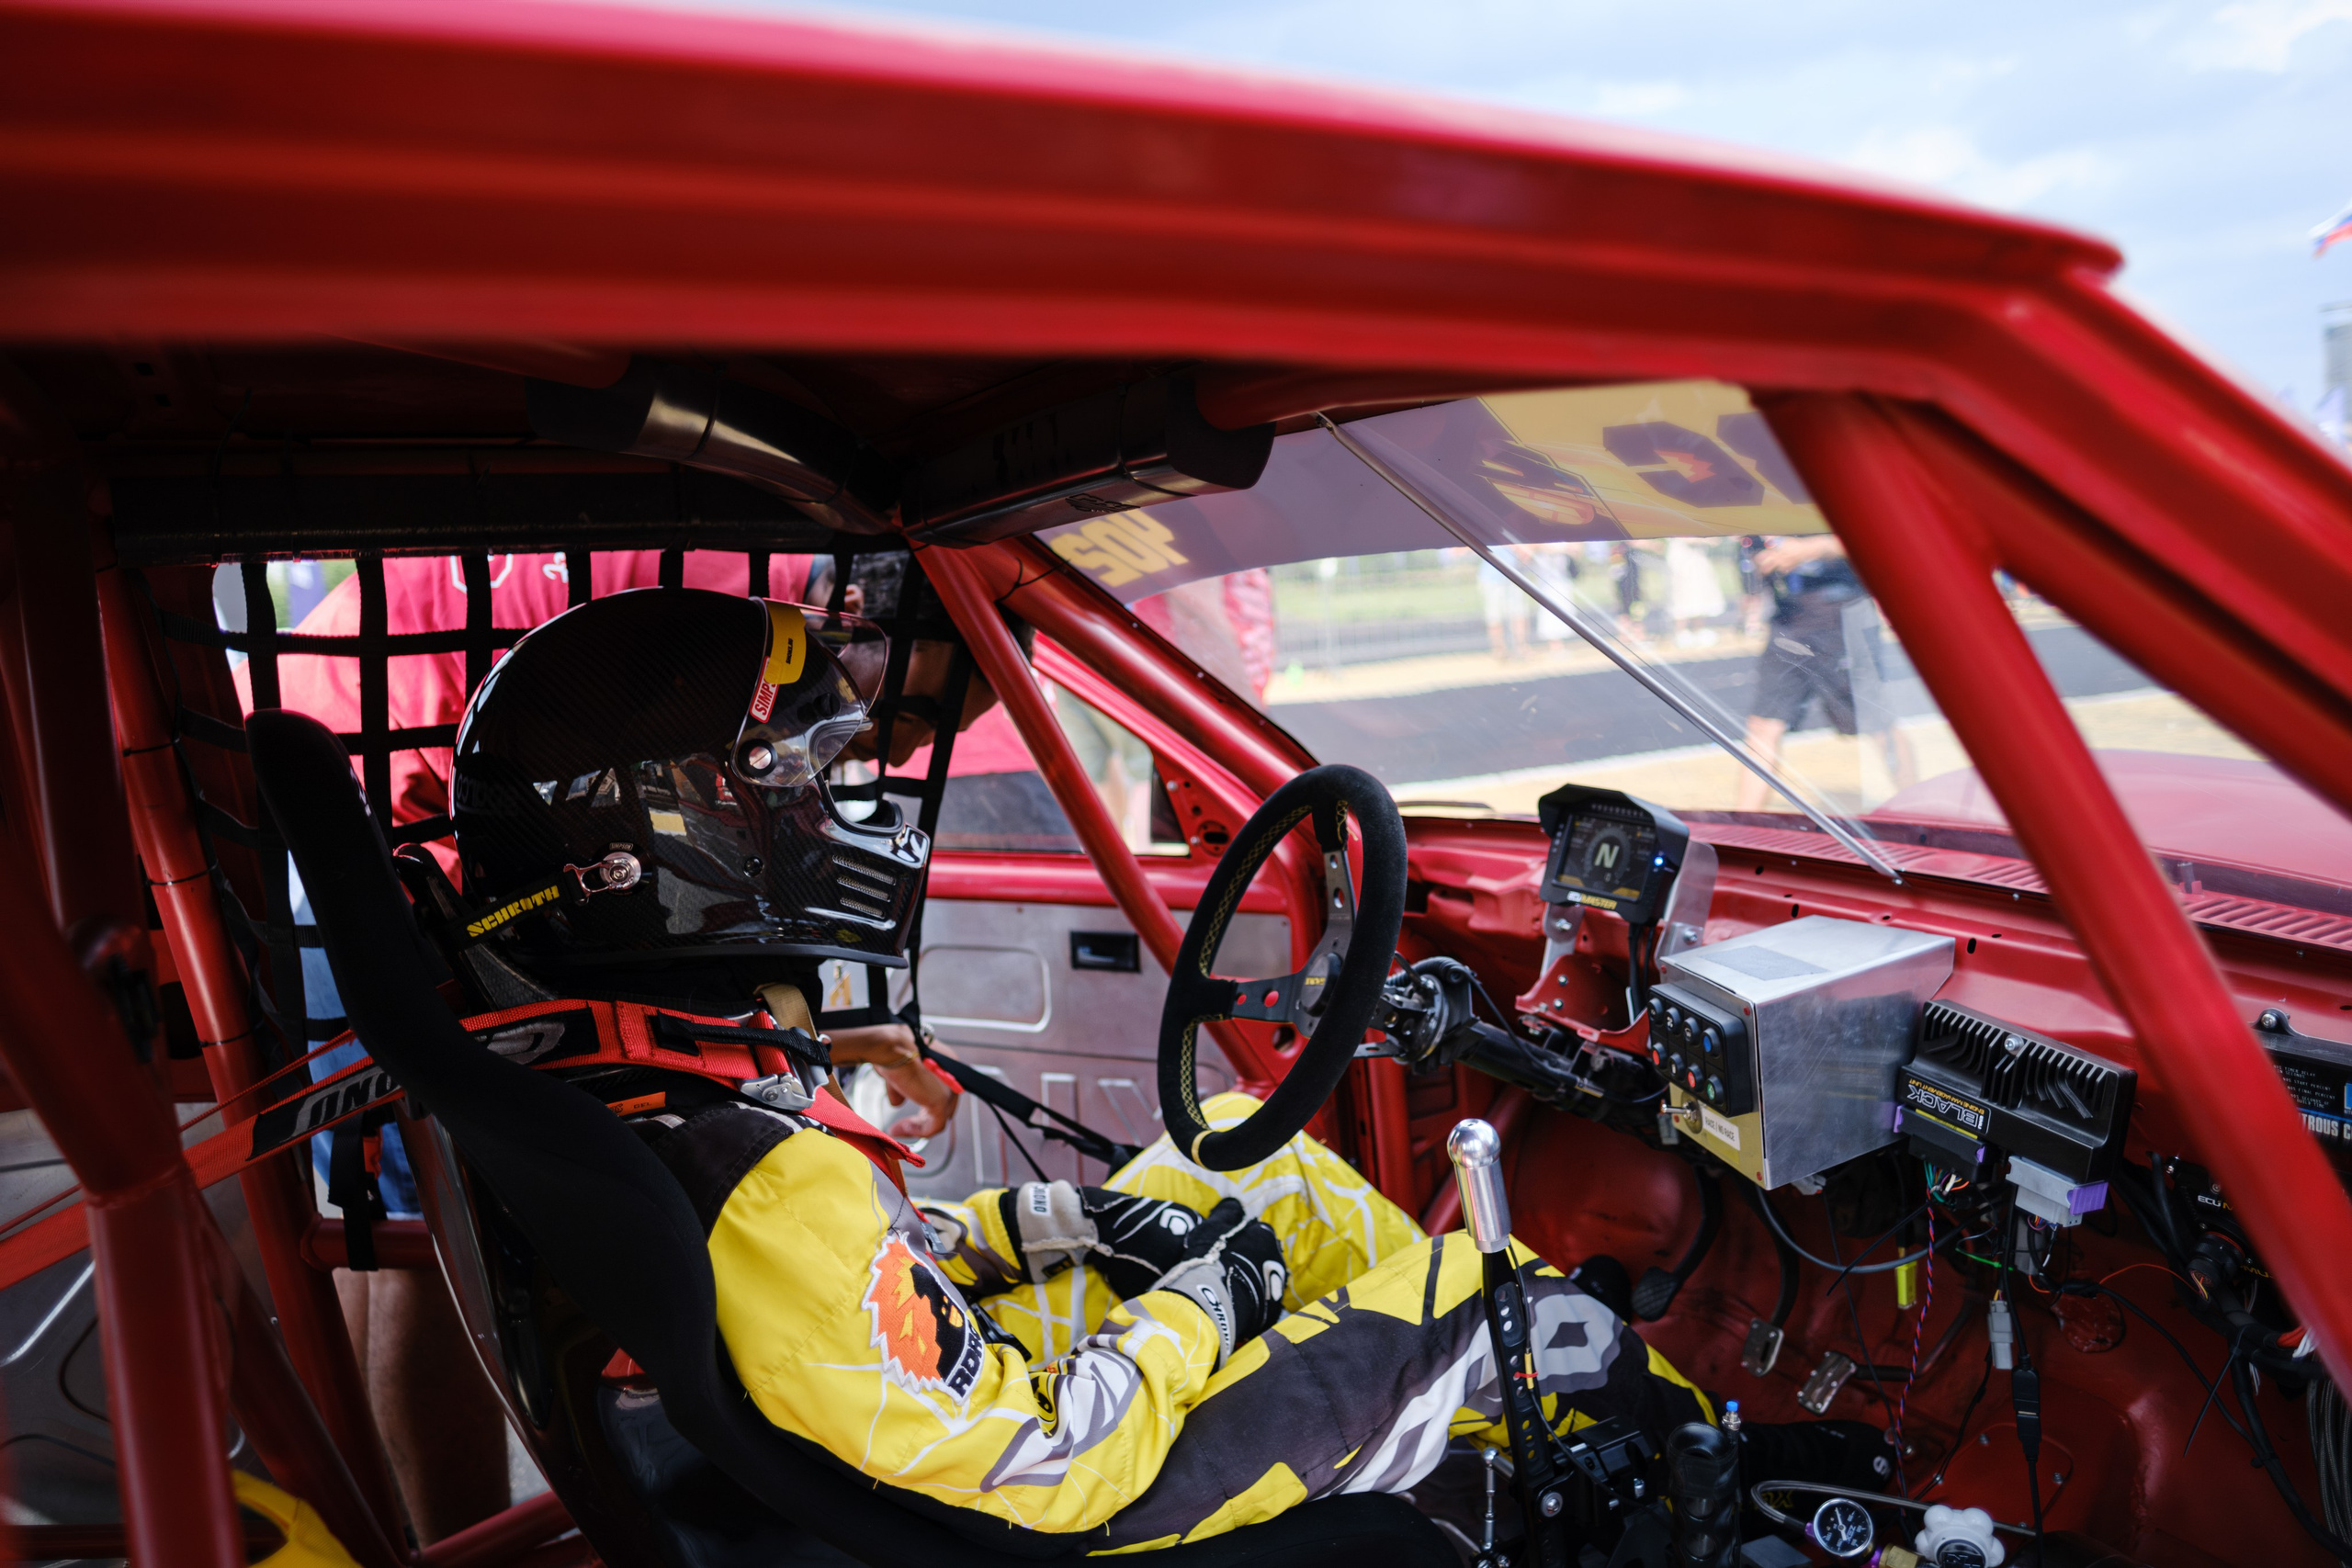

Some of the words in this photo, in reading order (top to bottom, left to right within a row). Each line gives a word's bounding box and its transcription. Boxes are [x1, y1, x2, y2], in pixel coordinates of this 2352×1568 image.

[754, 679, 781, 716] SIMP
[1594, 842, 1620, 869] N
[467, 885, 560, 938] SCHROTH
[1566, 890, 1618, 910] ECUMASTER
[2311, 1083, 2331, 1091] PERCENT
[1906, 1084, 1979, 1128] BLACK
[2300, 1112, 2338, 1137] TROUS
[2344, 1123, 2352, 1140] C
